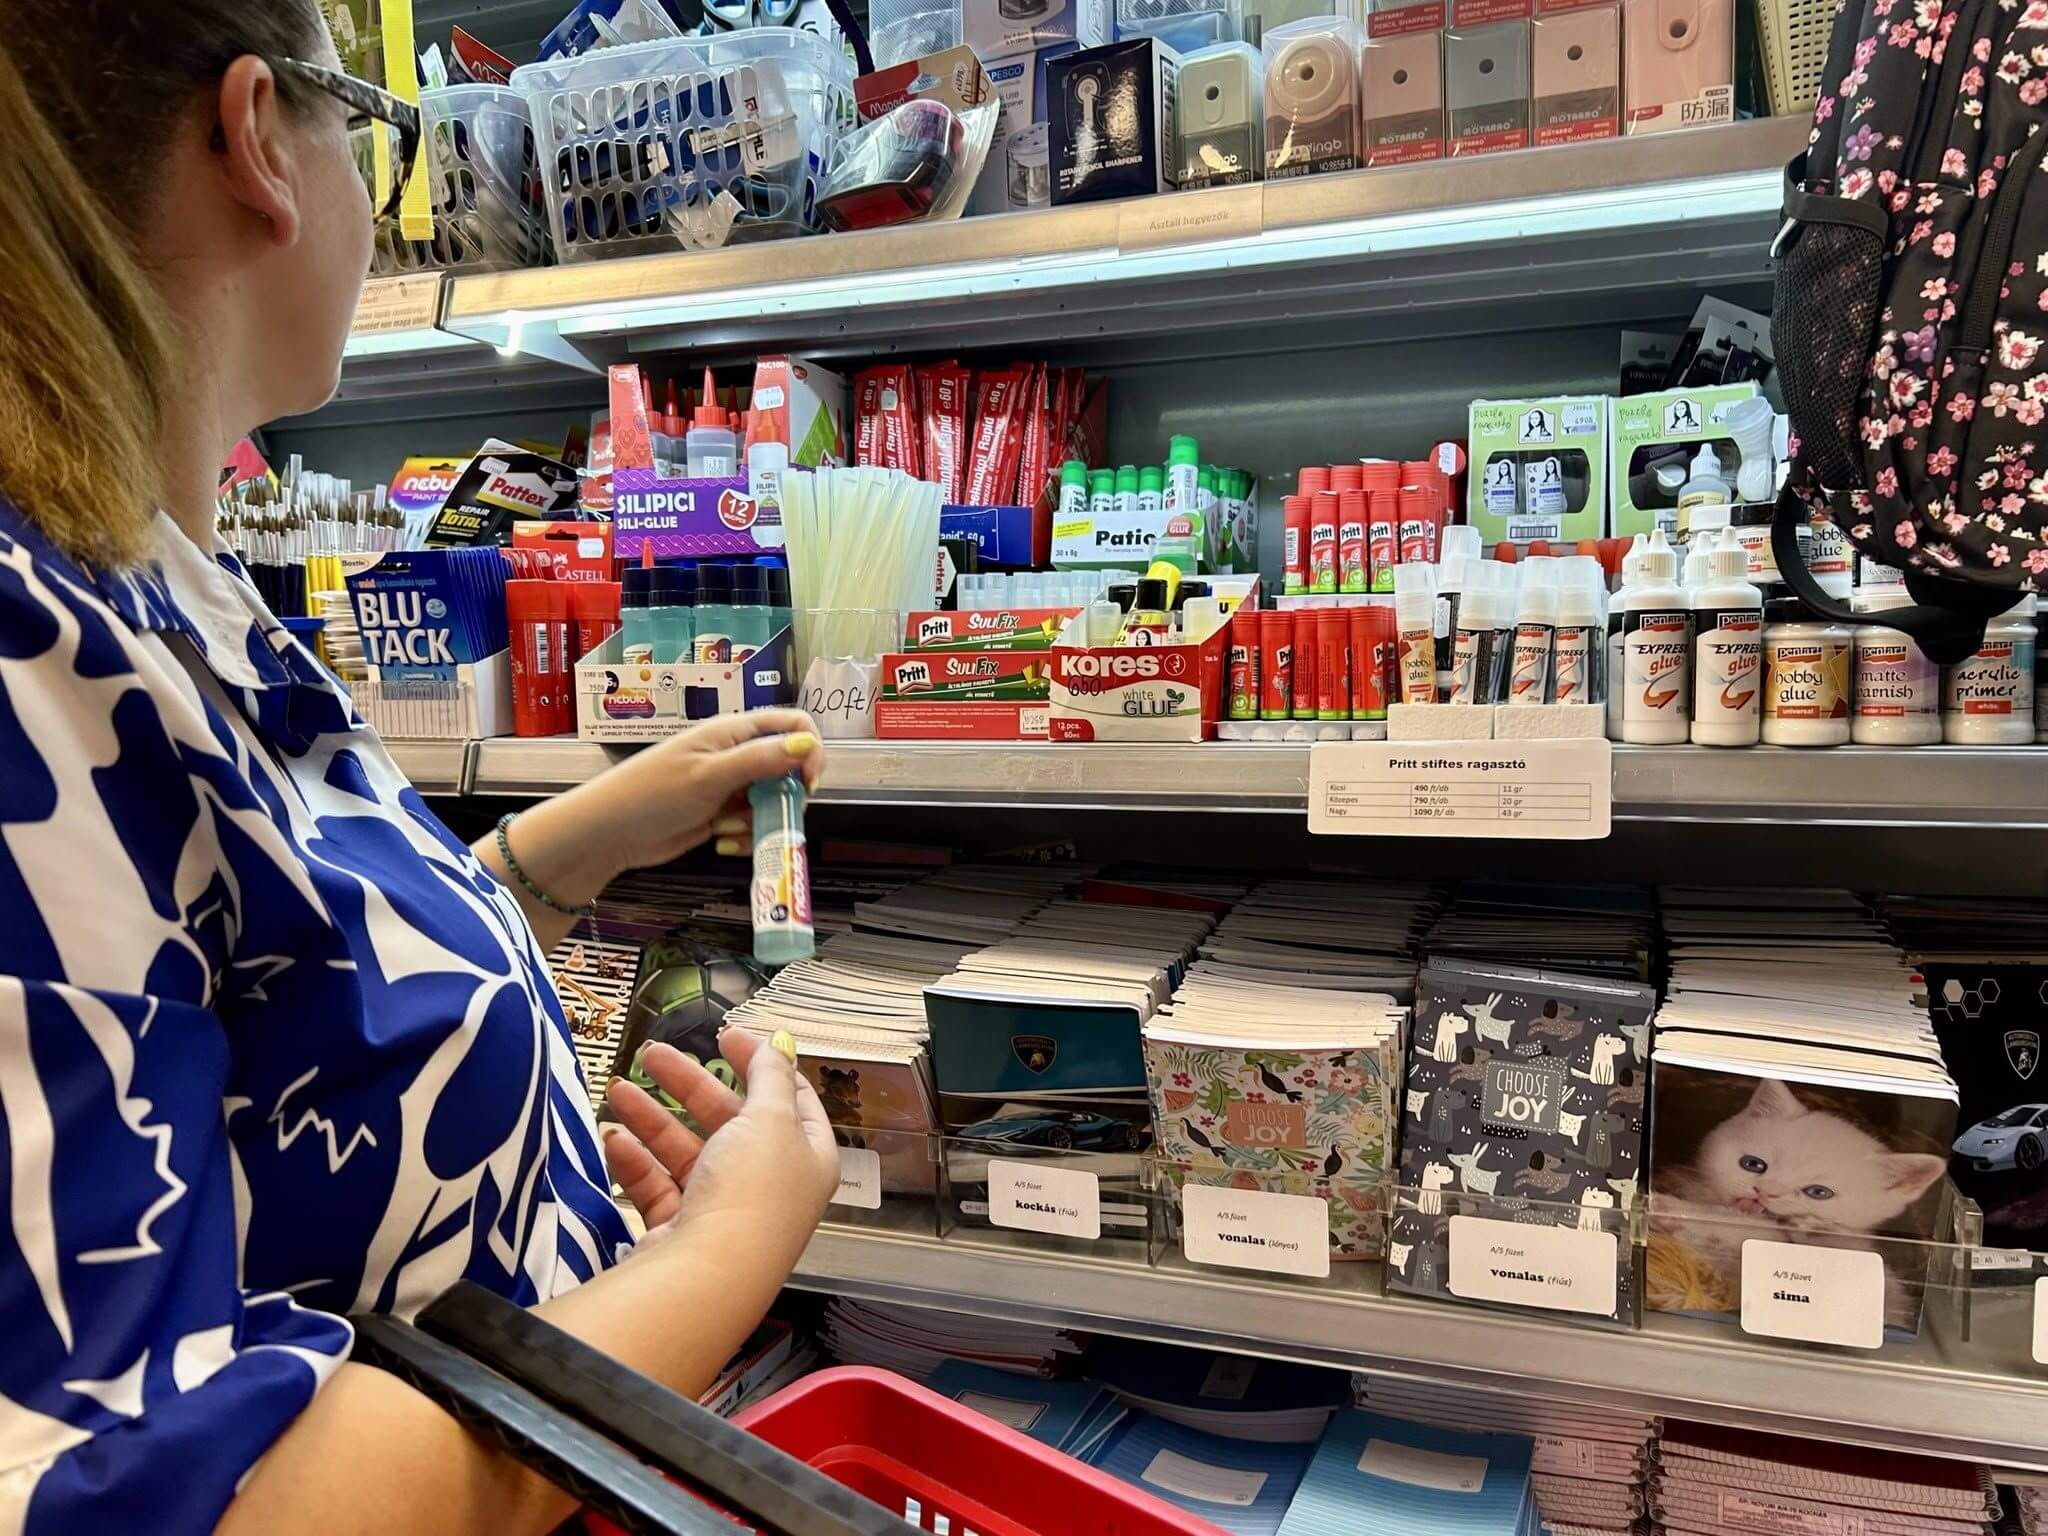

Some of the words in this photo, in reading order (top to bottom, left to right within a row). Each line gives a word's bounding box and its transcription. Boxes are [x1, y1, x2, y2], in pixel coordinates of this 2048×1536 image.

[1681, 97, 1730, 122] 防漏
[858, 415, 871, 449] Rapid
[886, 415, 896, 452] Rapid
[978, 416, 995, 451] Rapid
[404, 474, 457, 491] nebu
[969, 455, 988, 506] echnokol
[489, 476, 549, 509] Pattex
[458, 505, 491, 516] REPAIR
[617, 492, 696, 515] SILIPICI
[727, 498, 750, 518] 12
[440, 507, 482, 530] TOTAL
[617, 515, 678, 530] SILI-GLUE
[1169, 525, 1191, 534] GLUE
[1313, 527, 1333, 540] Pritt
[1341, 526, 1361, 539] Pritt
[1370, 525, 1389, 538] Pritt
[1401, 524, 1421, 537] Pritt
[1811, 530, 1848, 545] obby
[1810, 544, 1844, 559] glue
[554, 566, 606, 582] CASTELL
[357, 591, 422, 629] BLU
[921, 620, 949, 637] Pritt
[362, 628, 456, 666] TACK
[1649, 656, 1682, 676] glue
[1727, 656, 1758, 676] glue
[897, 666, 926, 684] Pritt
[1775, 669, 1824, 687] hobby
[1861, 670, 1906, 682] matte
[1956, 668, 2022, 681] acrylic
[1122, 688, 1154, 701] white
[1779, 685, 1818, 703] glue
[1856, 684, 1914, 701] varnish
[1956, 685, 2018, 701] primer
[1123, 700, 1180, 716] GLUE
[1389, 759, 1418, 770] Pritt
[1421, 758, 1464, 770] stiftes
[1467, 758, 1528, 772] ragasztó
[1329, 784, 1347, 792] Kicsi
[1413, 784, 1429, 793] 490
[1413, 796, 1429, 805] 790
[1328, 807, 1348, 817] Nagy
[1413, 808, 1434, 817] 1090
[1496, 1068, 1550, 1098] CHOOSE
[1239, 1107, 1290, 1126] CHOOSE
[1494, 1094, 1548, 1123] JOY
[1243, 1125, 1292, 1144] JOY
[1015, 1199, 1057, 1214] kockás
[1217, 1232, 1267, 1247] vonalas
[1490, 1268, 1545, 1283] vonalas
[1772, 1290, 1811, 1304] sima
